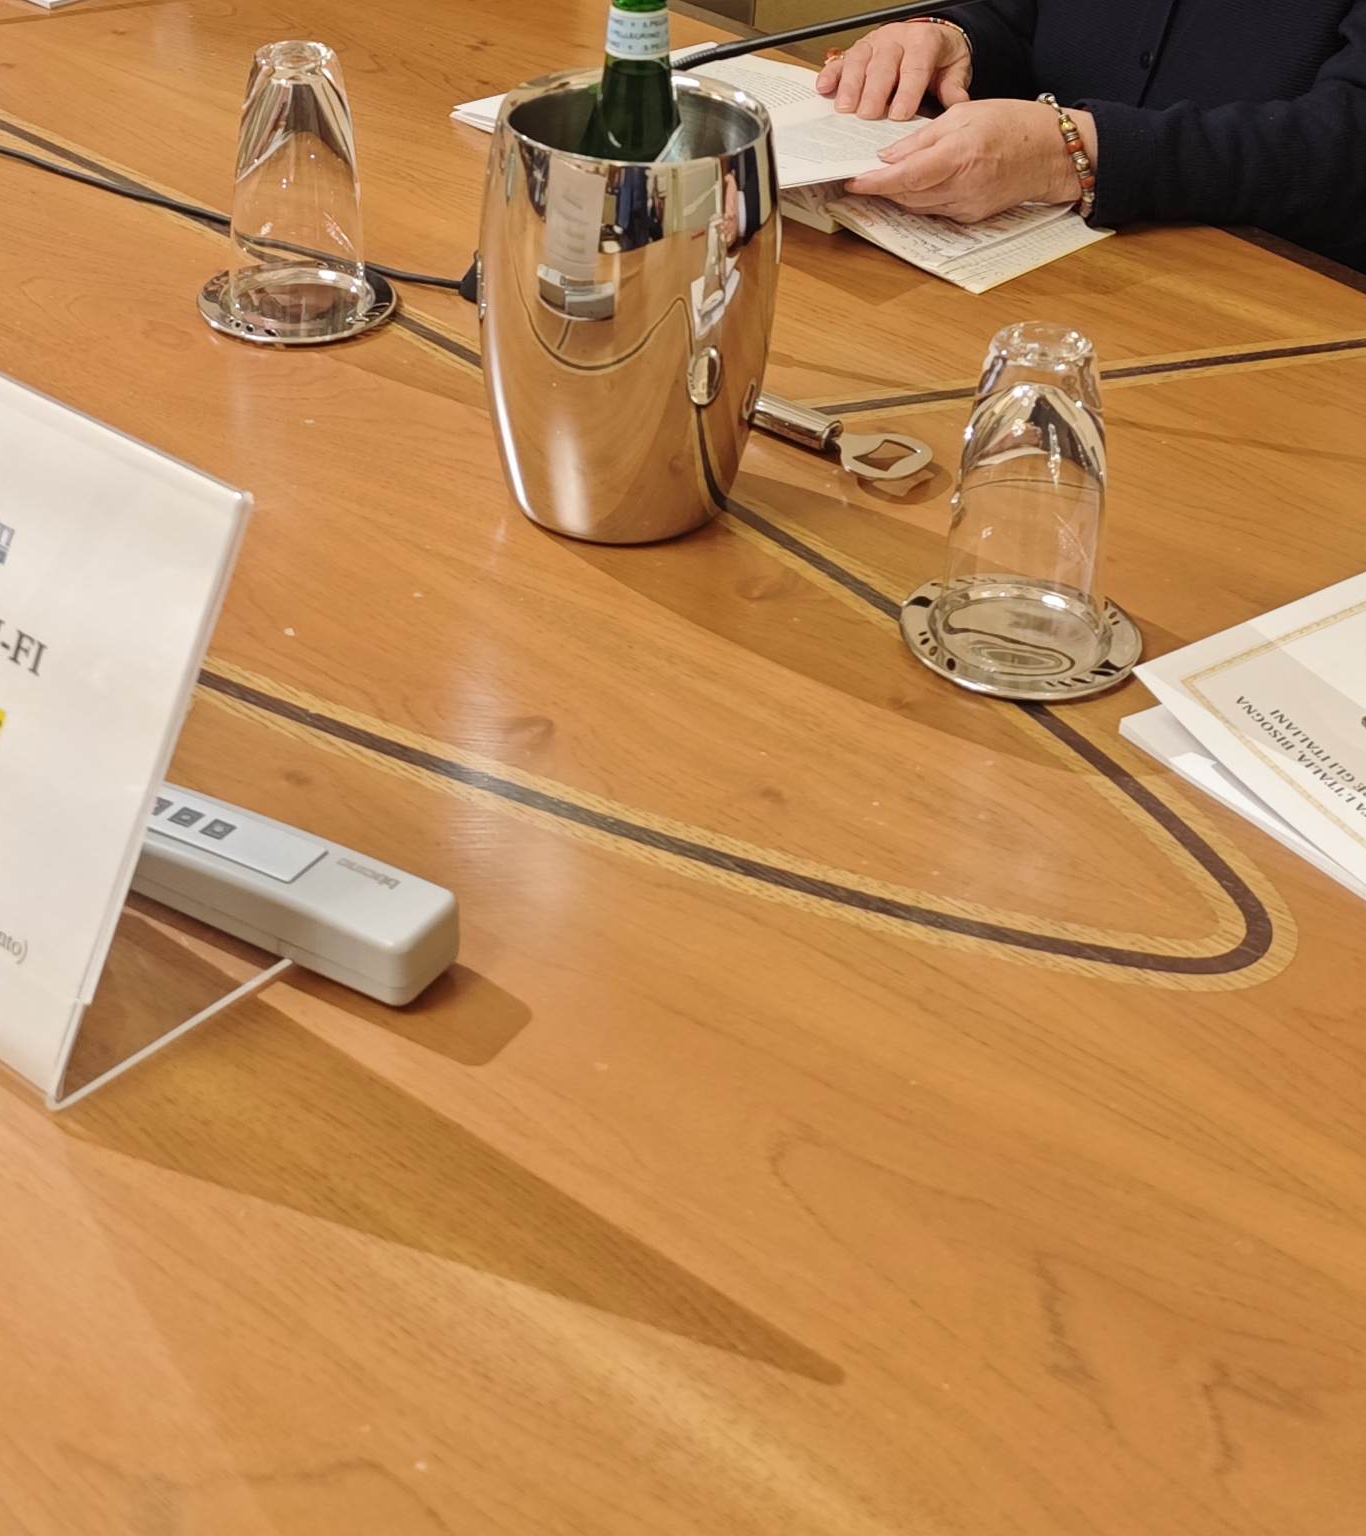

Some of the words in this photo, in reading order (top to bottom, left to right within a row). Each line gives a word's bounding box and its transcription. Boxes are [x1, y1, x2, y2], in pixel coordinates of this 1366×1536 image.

[1236, 695, 1295, 751] BISOGNA
[1270, 709, 1331, 762] ITALIANI
[1297, 750, 1356, 803] L'ITALIA,
[1329, 762, 1355, 783] GLI
